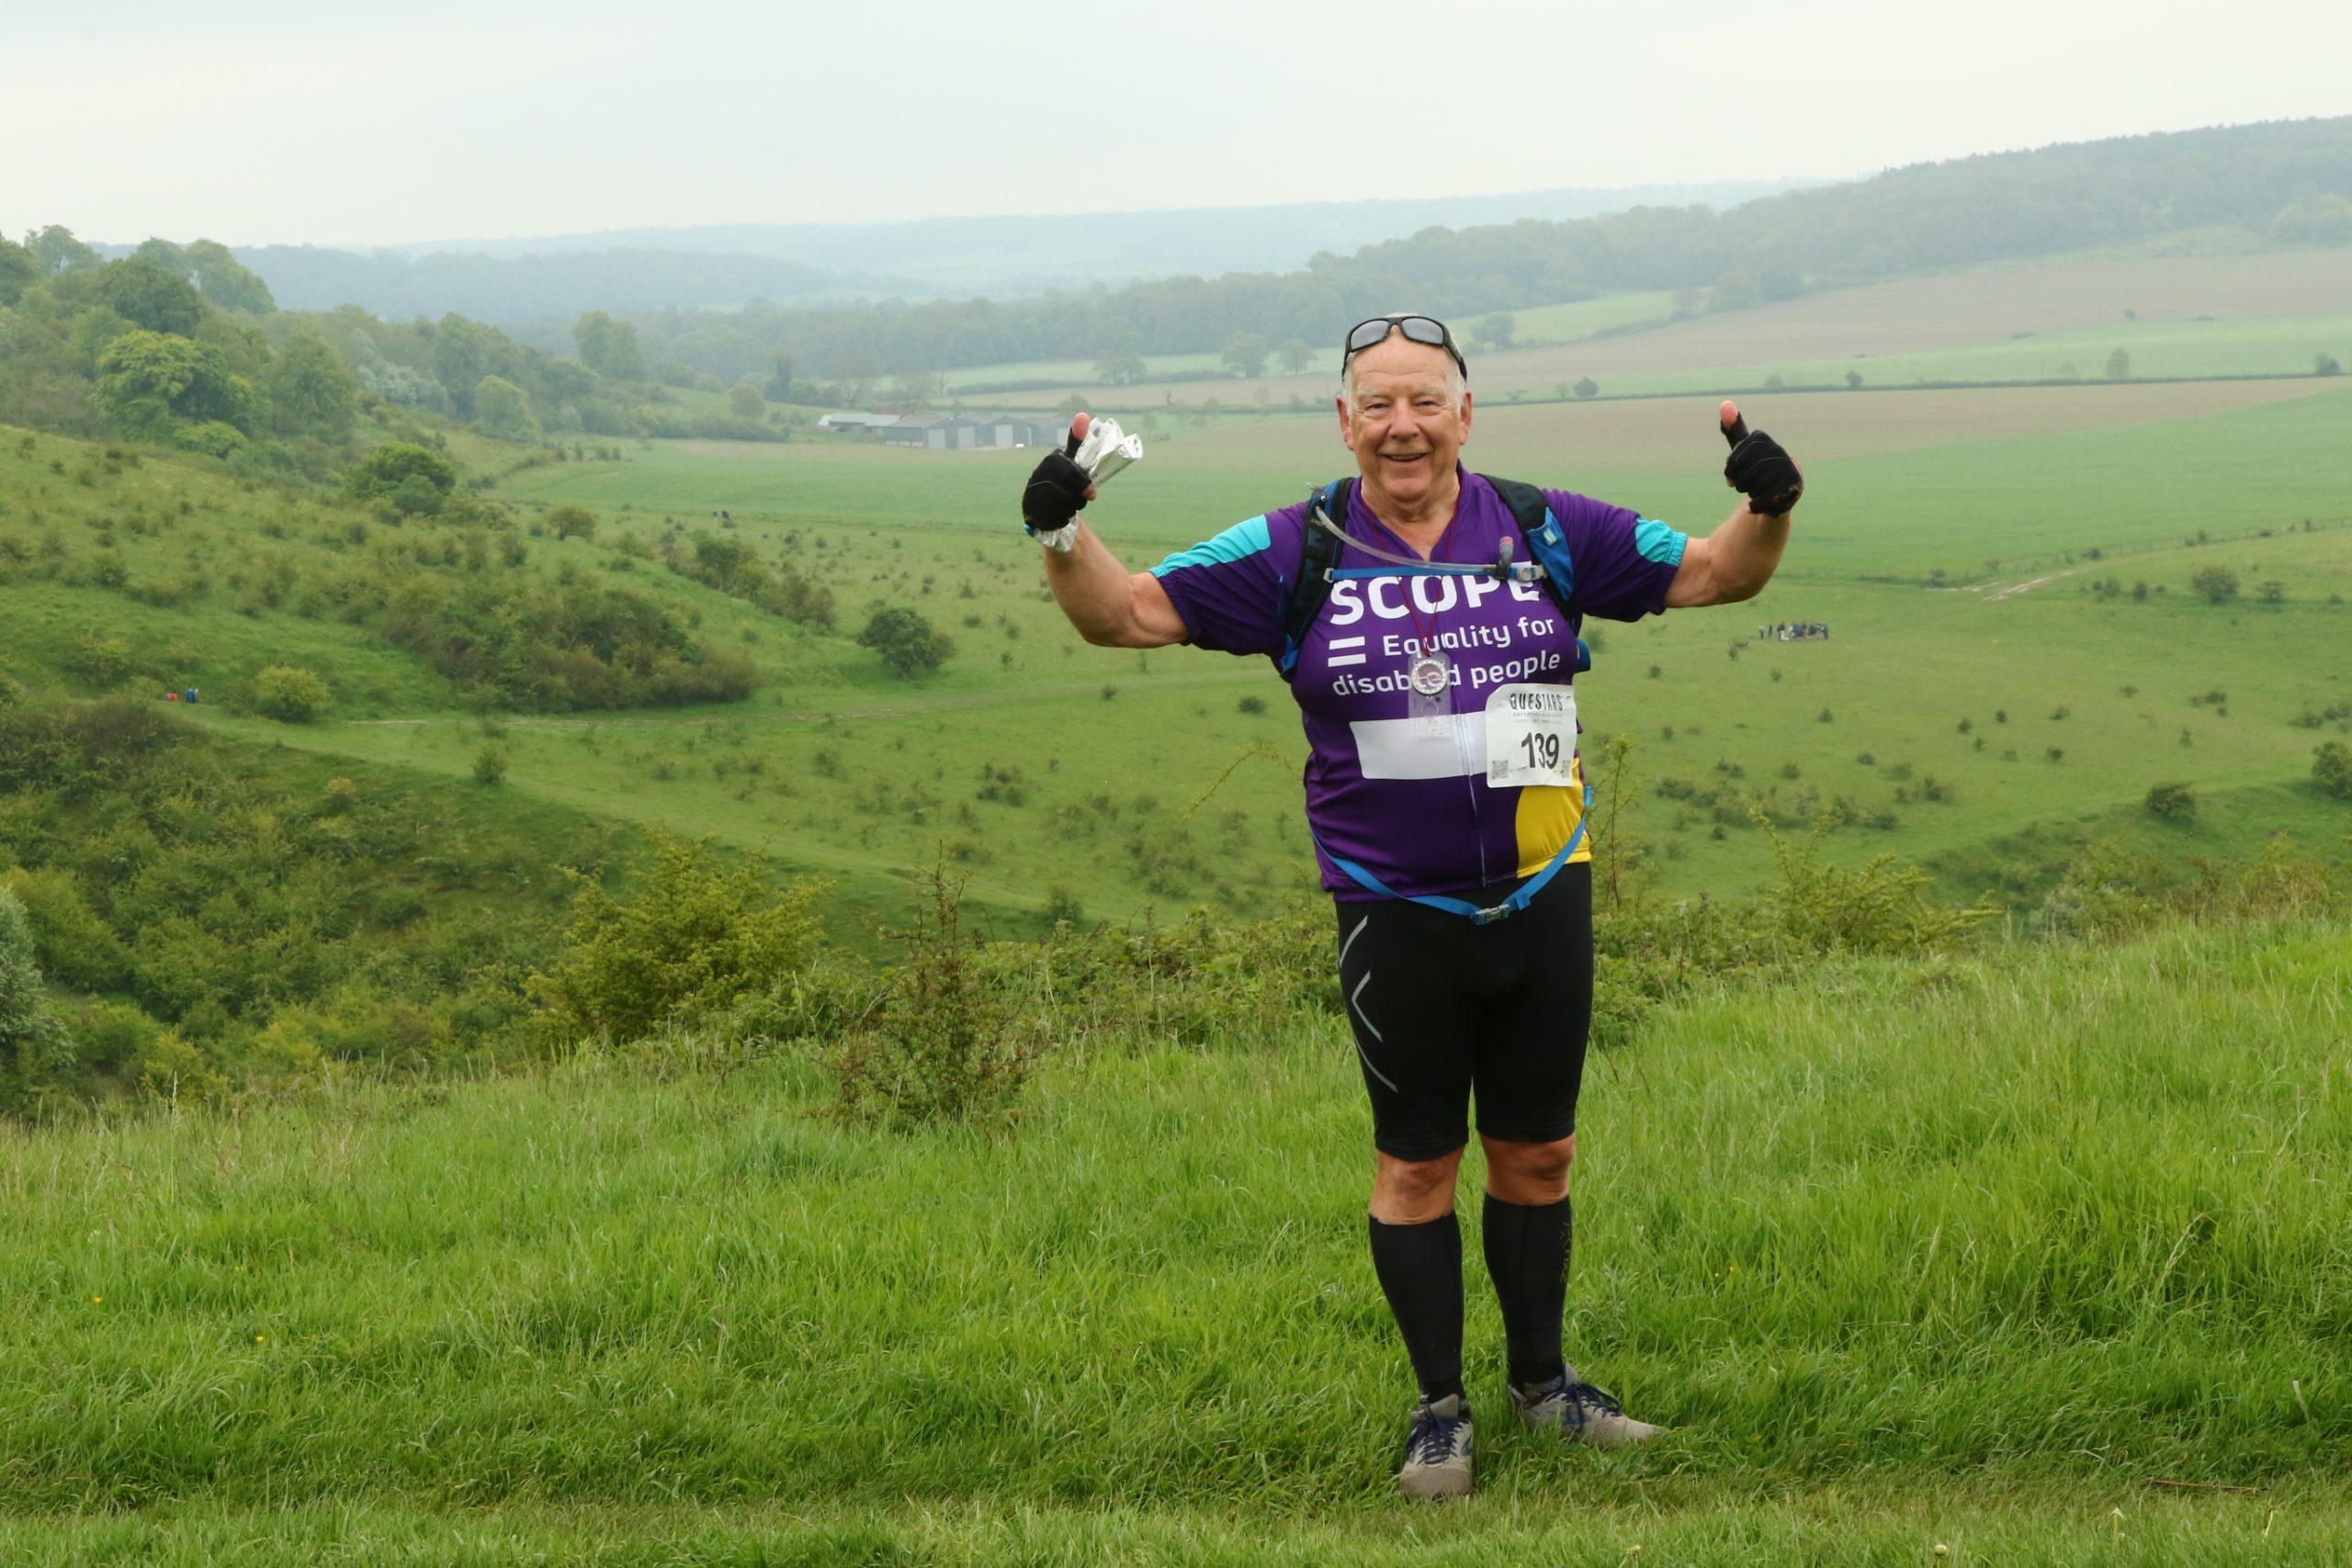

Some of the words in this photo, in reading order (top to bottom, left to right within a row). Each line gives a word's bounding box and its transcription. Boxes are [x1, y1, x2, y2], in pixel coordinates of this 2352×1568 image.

[1330, 561, 1540, 626] SCOPE
[1383, 625, 1511, 659] Equality
[1517, 616, 1555, 638] for
[1332, 664, 1462, 696] disabd
[1471, 650, 1560, 689] people
[1510, 693, 1563, 711] QUESTARS
[1521, 732, 1560, 770] 139
